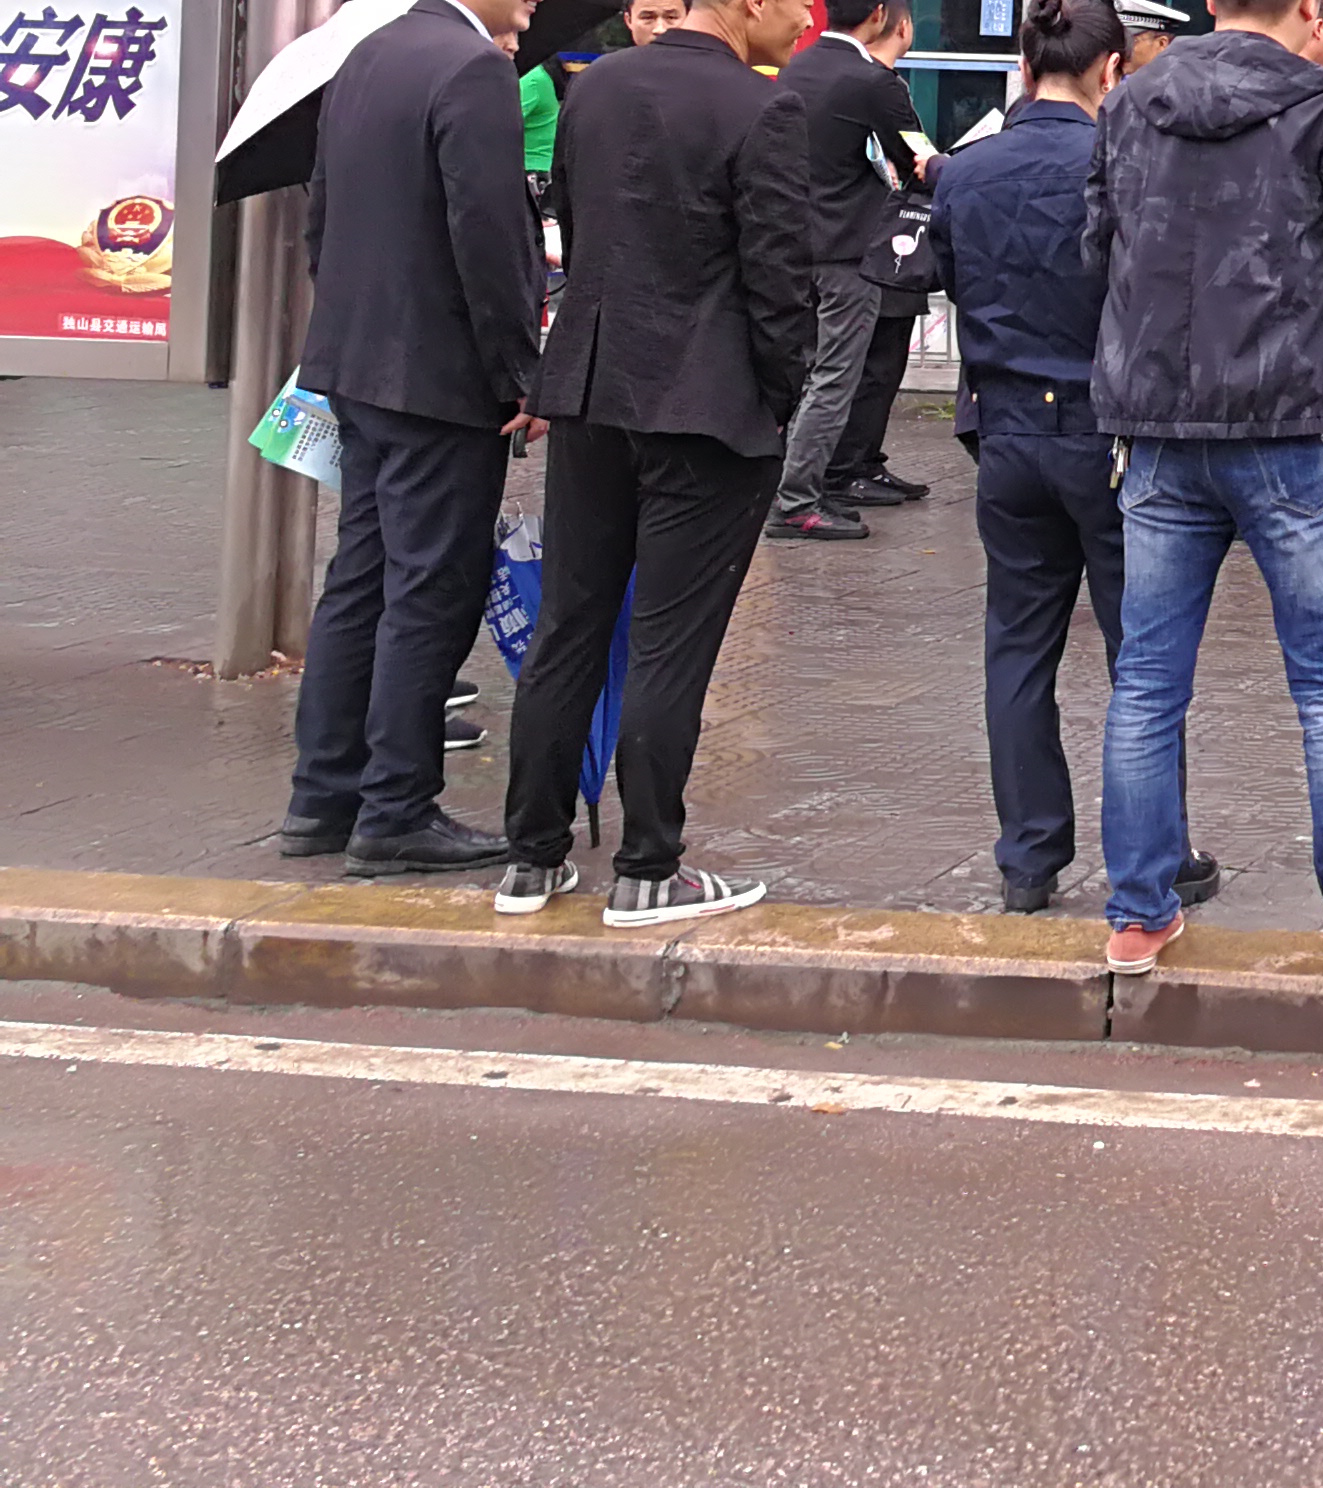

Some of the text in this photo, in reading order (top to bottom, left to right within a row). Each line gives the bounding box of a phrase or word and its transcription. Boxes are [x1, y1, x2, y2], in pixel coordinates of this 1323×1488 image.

[0, 5, 168, 122] 安康
[62, 315, 167, 337] 独山县交通运输局
